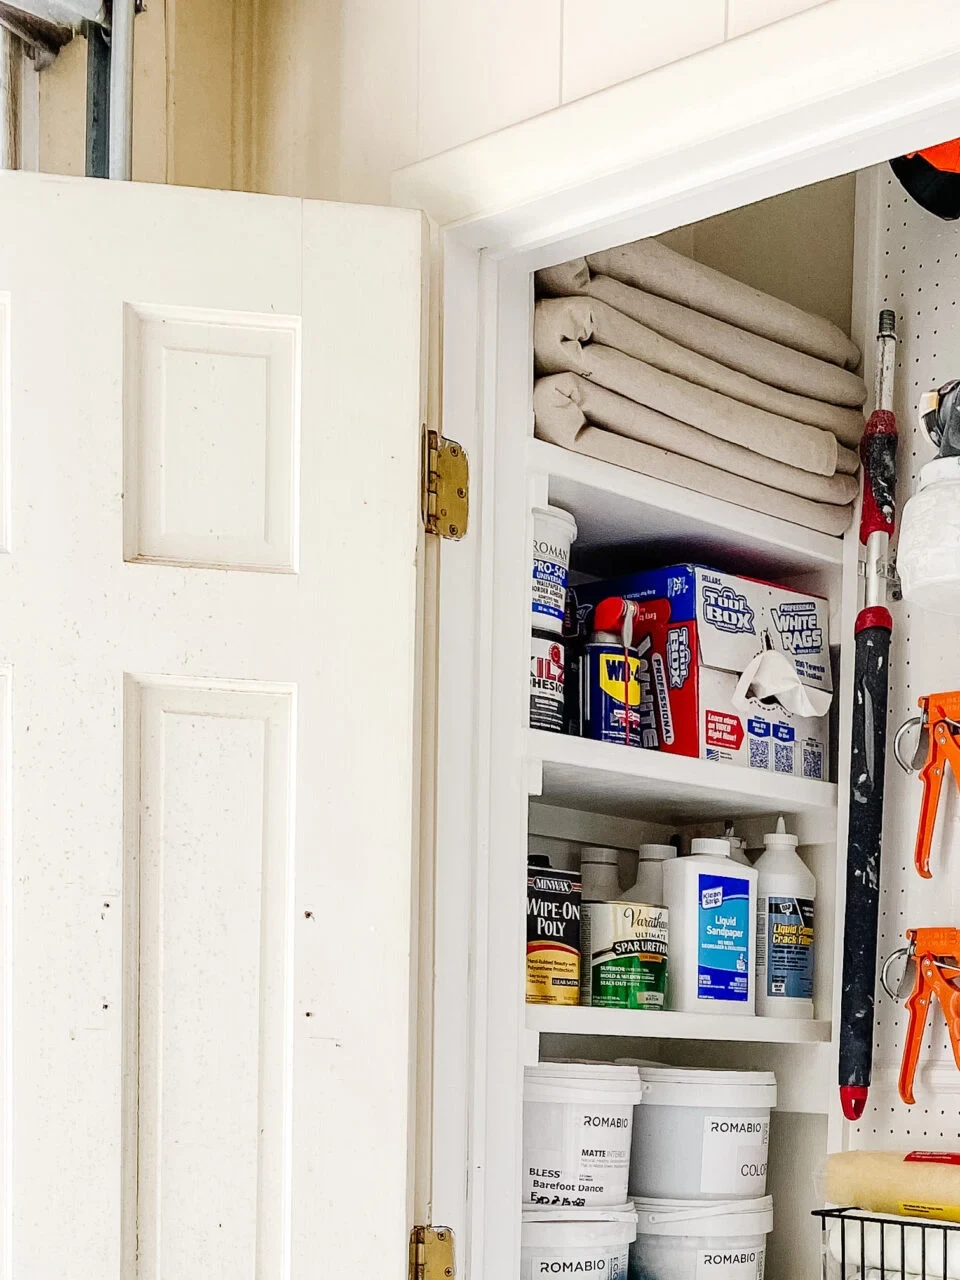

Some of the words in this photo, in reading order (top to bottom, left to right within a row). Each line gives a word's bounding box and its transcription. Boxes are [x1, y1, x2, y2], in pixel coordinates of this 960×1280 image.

[705, 591, 748, 613] TOOL
[706, 605, 752, 629] BOX
[771, 609, 817, 631] WHITE
[782, 630, 822, 654] RAGS
[669, 629, 682, 688] BOX
[653, 658, 673, 742] PROFESSIONAL
[536, 878, 570, 892] MINWAX
[715, 915, 737, 927] Liquid
[706, 926, 744, 939] Sandpaper
[773, 934, 797, 944] Crack
[615, 943, 640, 954] SPAR
[583, 1116, 629, 1128] ROMABIO
[711, 1122, 762, 1133] ROMABIO
[581, 1149, 606, 1158] MATTE
[533, 1180, 576, 1191] Barefoot
[578, 1185, 604, 1193] Dance
[703, 1252, 756, 1265] ROMABIO
[540, 1259, 606, 1273] ROMABIO
